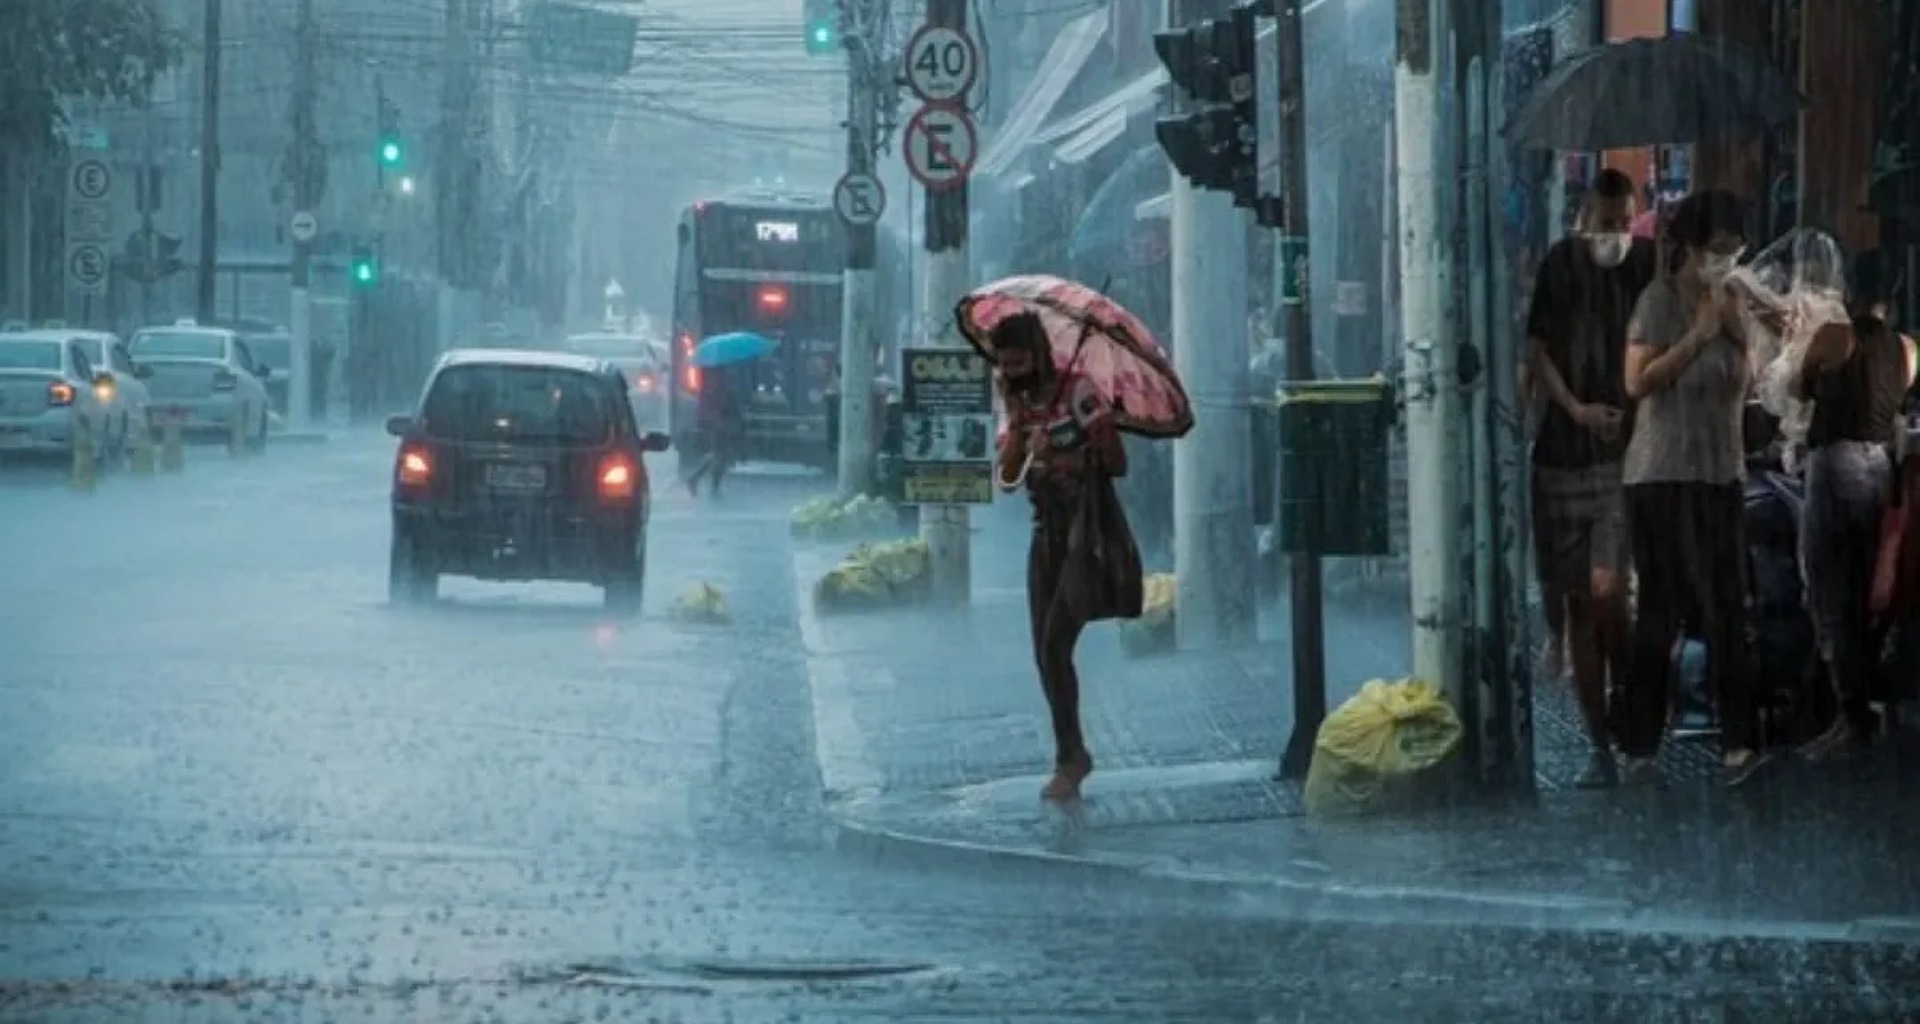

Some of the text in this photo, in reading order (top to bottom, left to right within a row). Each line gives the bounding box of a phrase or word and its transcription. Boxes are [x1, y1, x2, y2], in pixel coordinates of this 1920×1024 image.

[915, 42, 966, 77] 40
[927, 124, 953, 169] E
[86, 168, 98, 191] E
